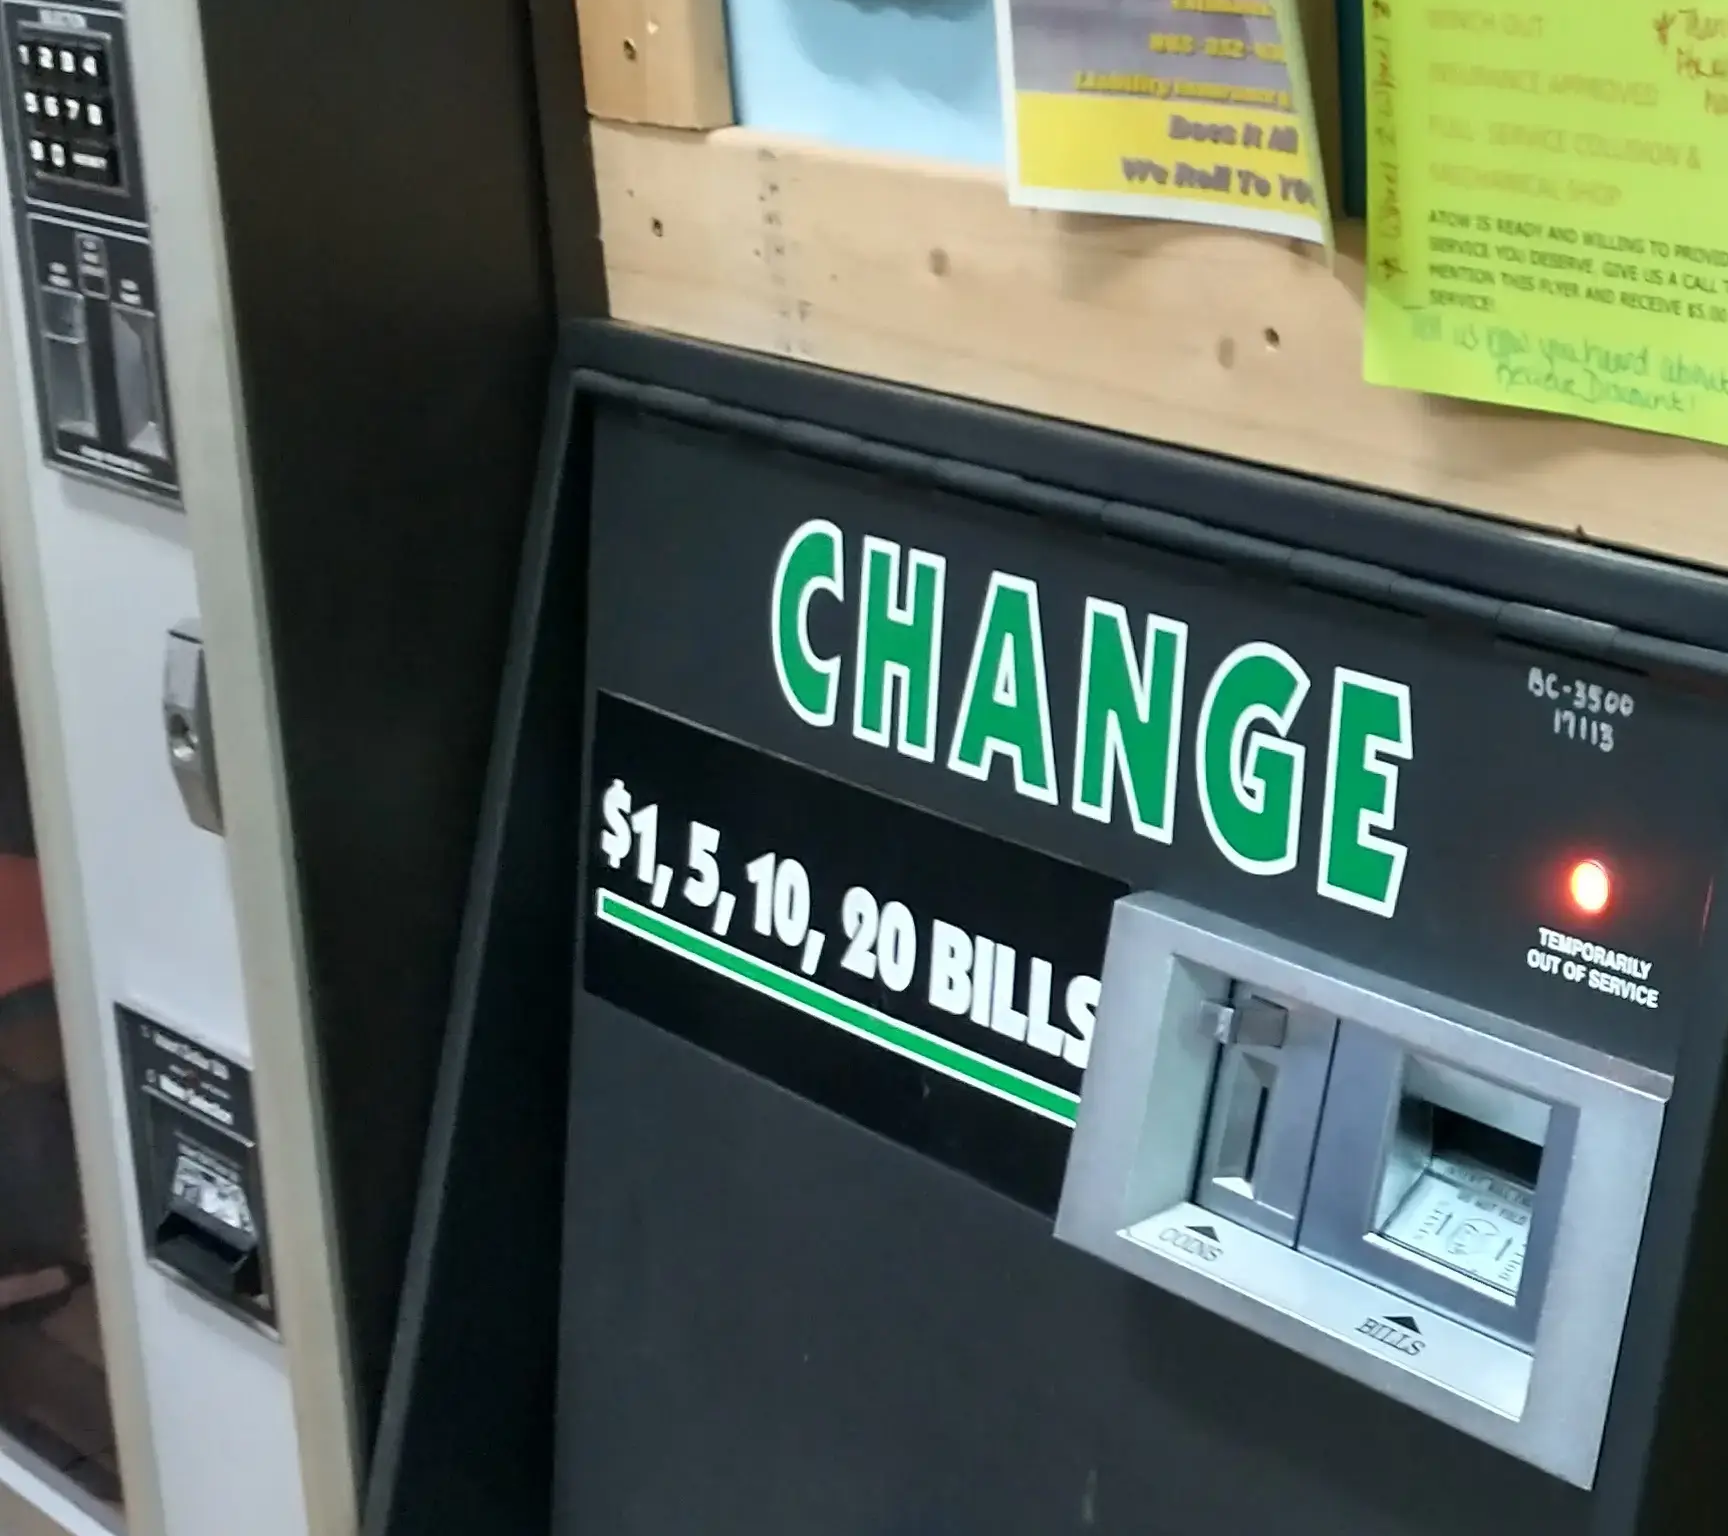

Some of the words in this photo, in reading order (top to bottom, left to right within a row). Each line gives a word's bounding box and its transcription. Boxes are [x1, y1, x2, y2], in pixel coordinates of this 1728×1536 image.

[1120, 155, 1169, 185] We
[1174, 161, 1231, 193] Roll
[1548, 225, 1579, 244] AND
[1649, 239, 1670, 259] TO
[1585, 285, 1617, 306] AND
[1643, 267, 1664, 286] US
[1667, 269, 1679, 287] A
[1683, 272, 1719, 295] CALL
[770, 519, 1415, 920] CHANGE
[600, 779, 673, 910] $1,
[682, 821, 737, 938] 5,
[746, 850, 827, 978] 10,
[841, 886, 916, 994] 20
[929, 917, 1103, 1071] BILLS
[1538, 925, 1652, 981] TEMPORARILY
[1526, 947, 1561, 977] OUT
[1562, 960, 1587, 983] OF
[1587, 967, 1660, 1009] SERVICE
[1158, 1227, 1224, 1262] COINS
[1354, 1316, 1427, 1357] BILLS
